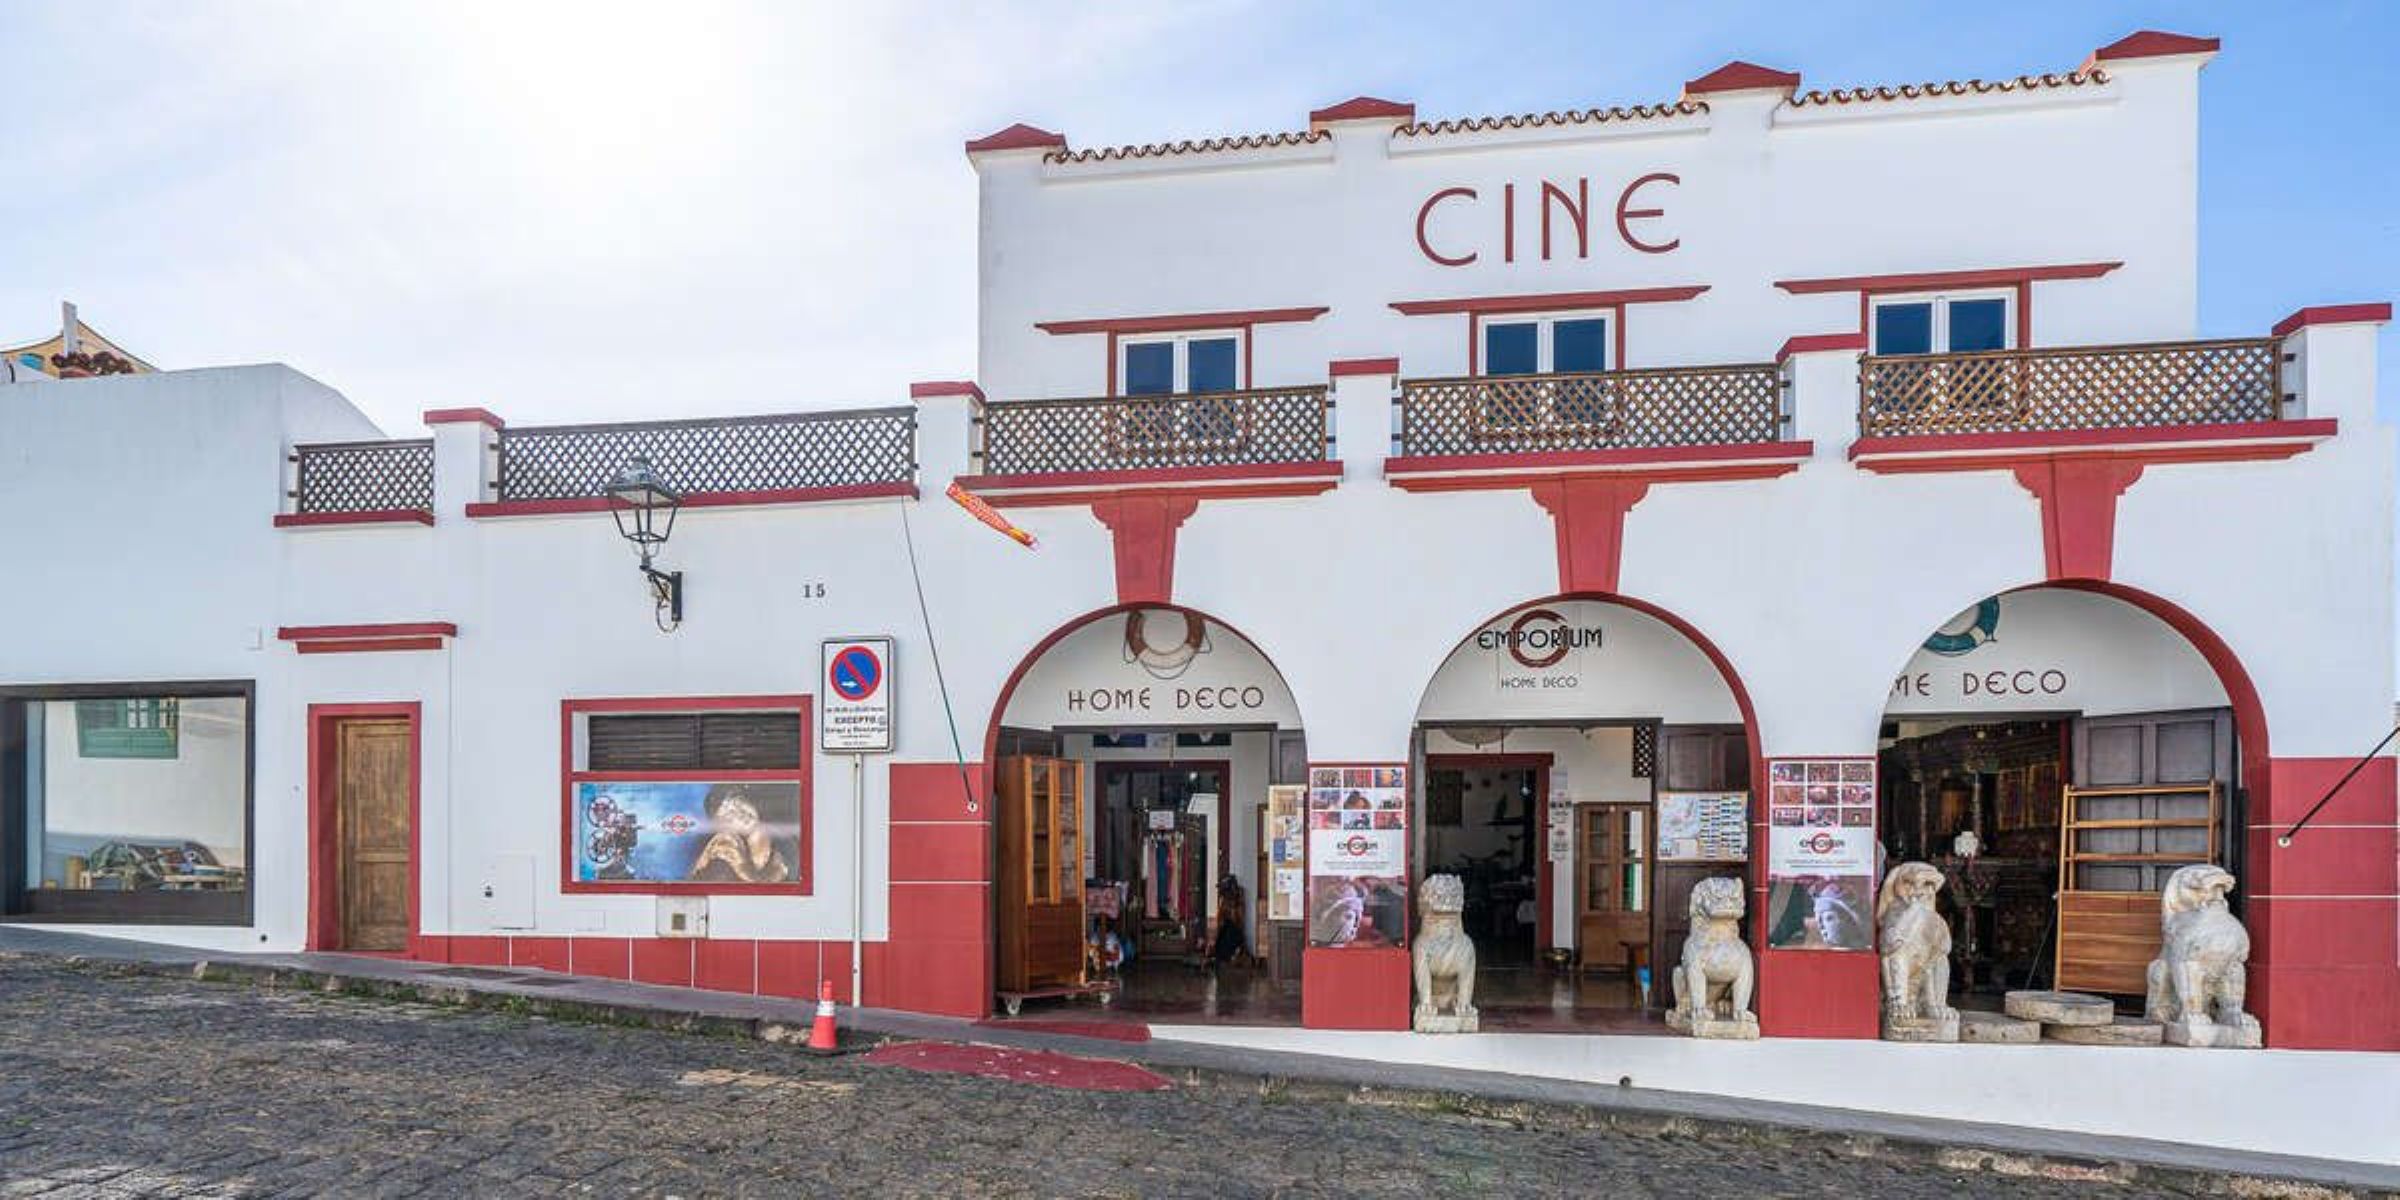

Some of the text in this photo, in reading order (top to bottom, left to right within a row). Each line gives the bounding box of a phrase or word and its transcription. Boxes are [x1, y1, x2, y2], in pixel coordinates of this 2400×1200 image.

[1416, 172, 1681, 267] CINE
[803, 583, 826, 598] 15
[1477, 625, 1603, 650] EMPORIUM
[1501, 675, 1579, 689] HOME DECO
[1889, 669, 2067, 697] ME DECO
[1068, 686, 1265, 711] HOME DECO
